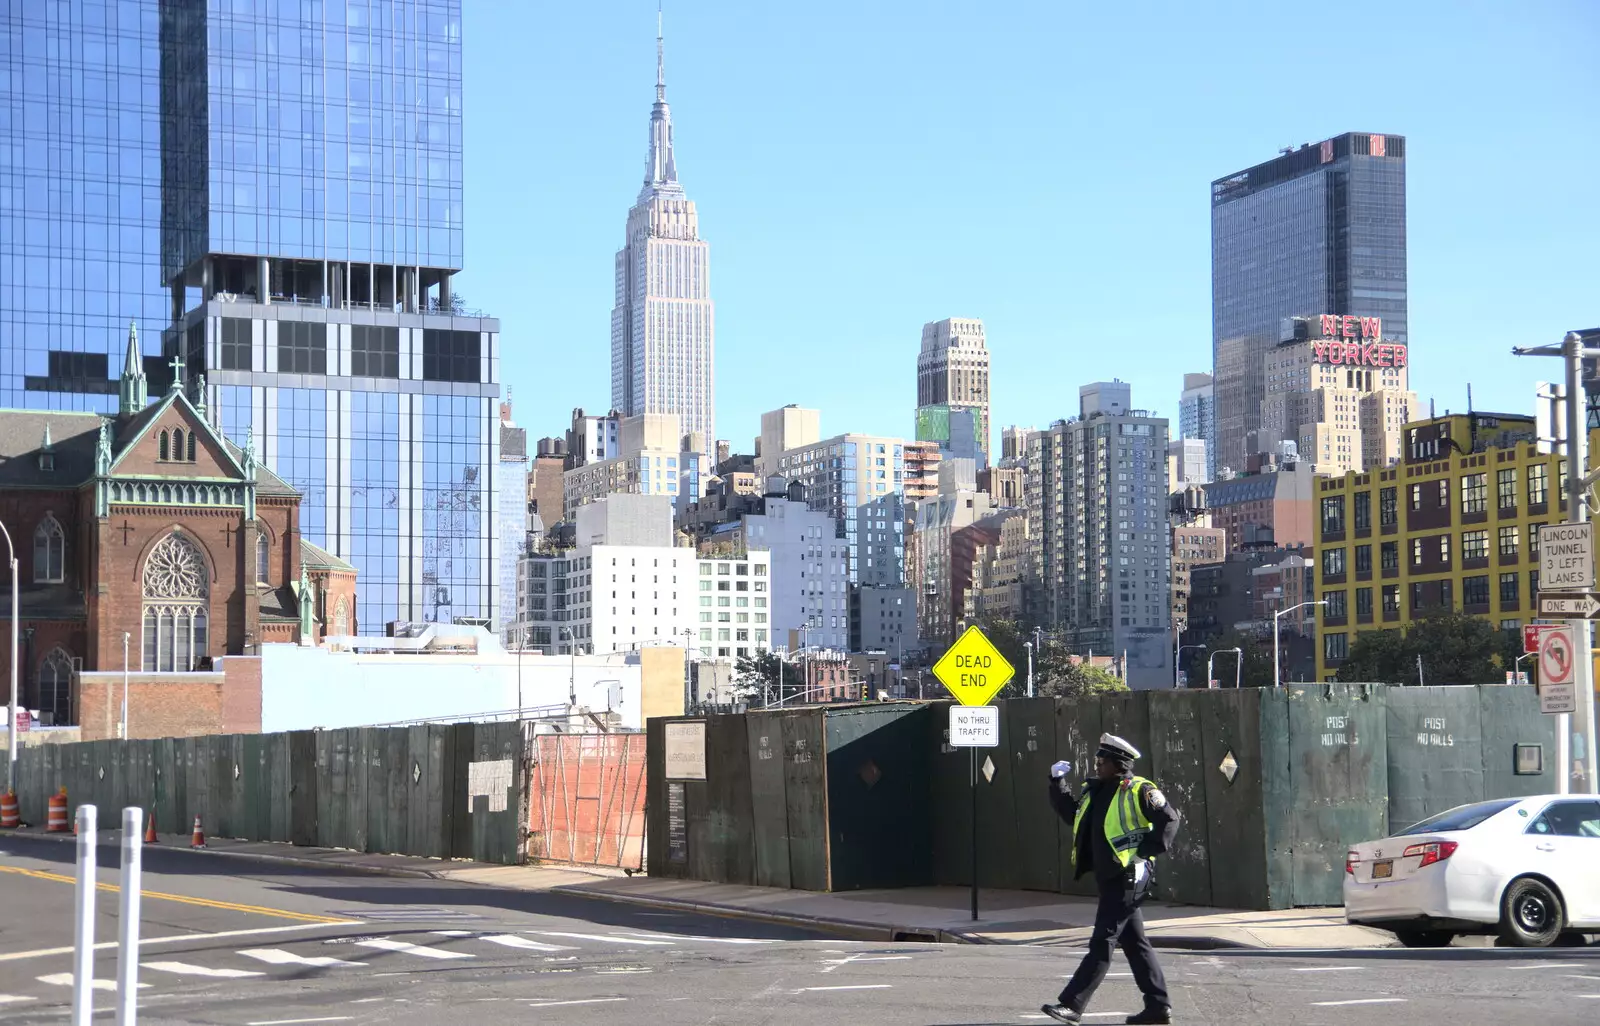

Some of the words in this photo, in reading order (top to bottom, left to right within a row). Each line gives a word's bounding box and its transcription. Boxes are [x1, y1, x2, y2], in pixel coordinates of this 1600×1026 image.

[1322, 314, 1380, 338] NEW
[1313, 341, 1408, 367] YORKER
[1543, 528, 1588, 542] LINCOLN
[1545, 543, 1587, 556] TUNNEL
[1547, 559, 1554, 570] 3
[1559, 557, 1585, 569] LEFT
[1548, 571, 1585, 584] LANES
[1546, 600, 1566, 612] ONE
[1574, 600, 1596, 612] WAY
[955, 654, 992, 668] DEAD
[960, 673, 987, 687] END
[957, 716, 968, 724] NO
[971, 716, 990, 724] THRU
[1326, 710, 1349, 729] POST
[1424, 717, 1446, 730] POST
[958, 728, 990, 736] TRAFFIC
[1321, 733, 1333, 746] NO
[1417, 732, 1429, 746] NO
[1430, 732, 1454, 747] BILLS
